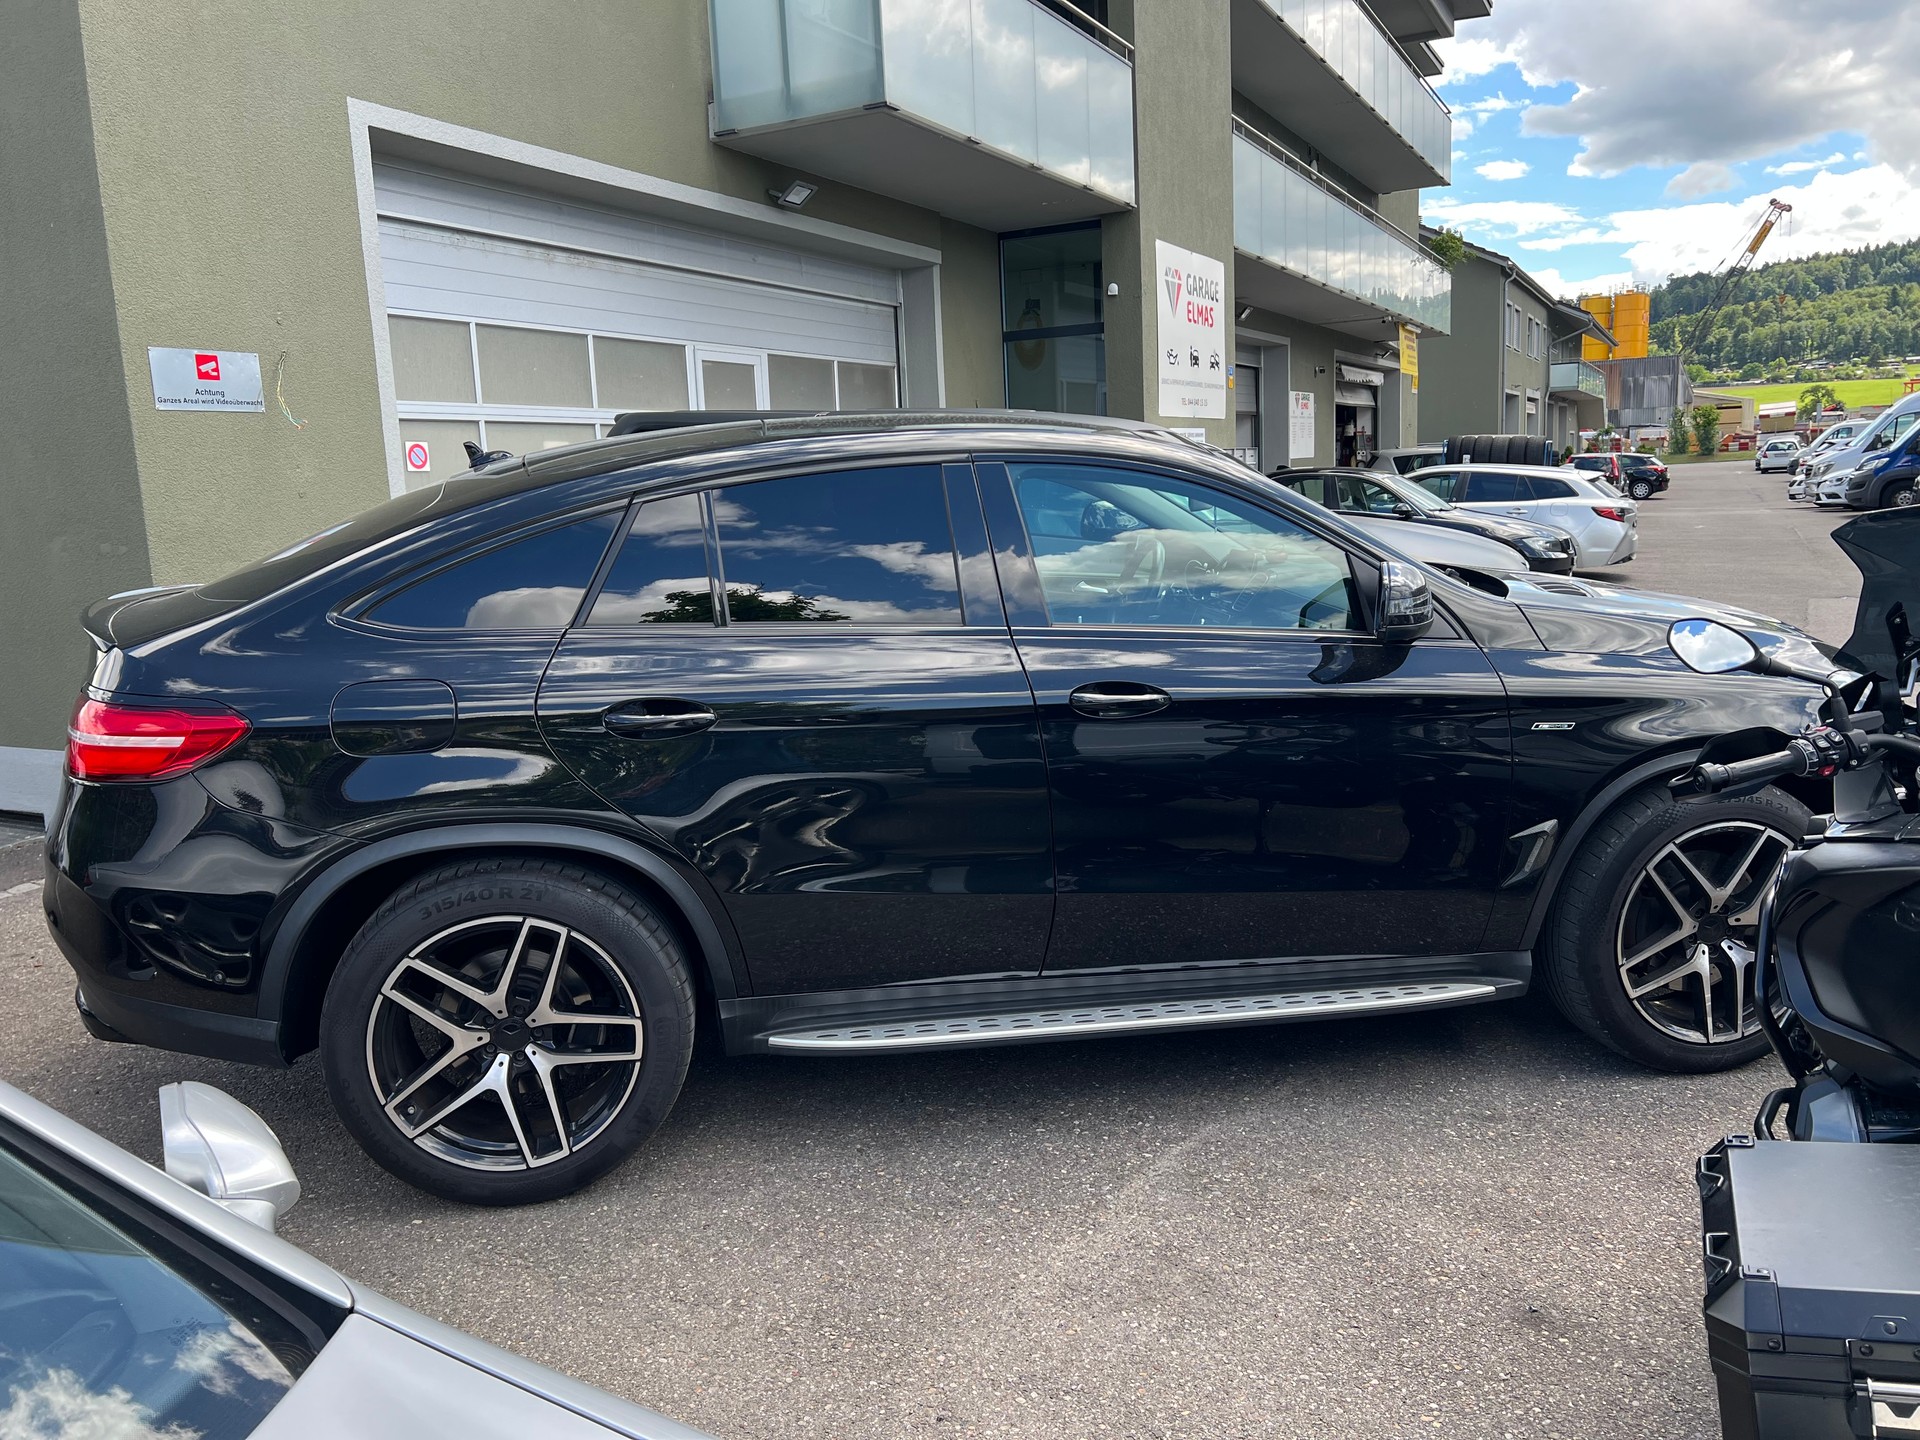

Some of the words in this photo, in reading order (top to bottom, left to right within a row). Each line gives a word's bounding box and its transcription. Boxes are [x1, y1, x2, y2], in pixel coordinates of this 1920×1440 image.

[1186, 273, 1219, 303] GARAGE
[1187, 301, 1214, 328] ELMAS
[157, 396, 182, 404] Ganzes
[183, 397, 200, 405] Areal
[194, 388, 225, 398] Achtung
[1765, 798, 1774, 809] R
[1776, 802, 1789, 814] 21
[419, 888, 494, 920] 315/40
[500, 887, 514, 899] R
[520, 887, 541, 901] 21
